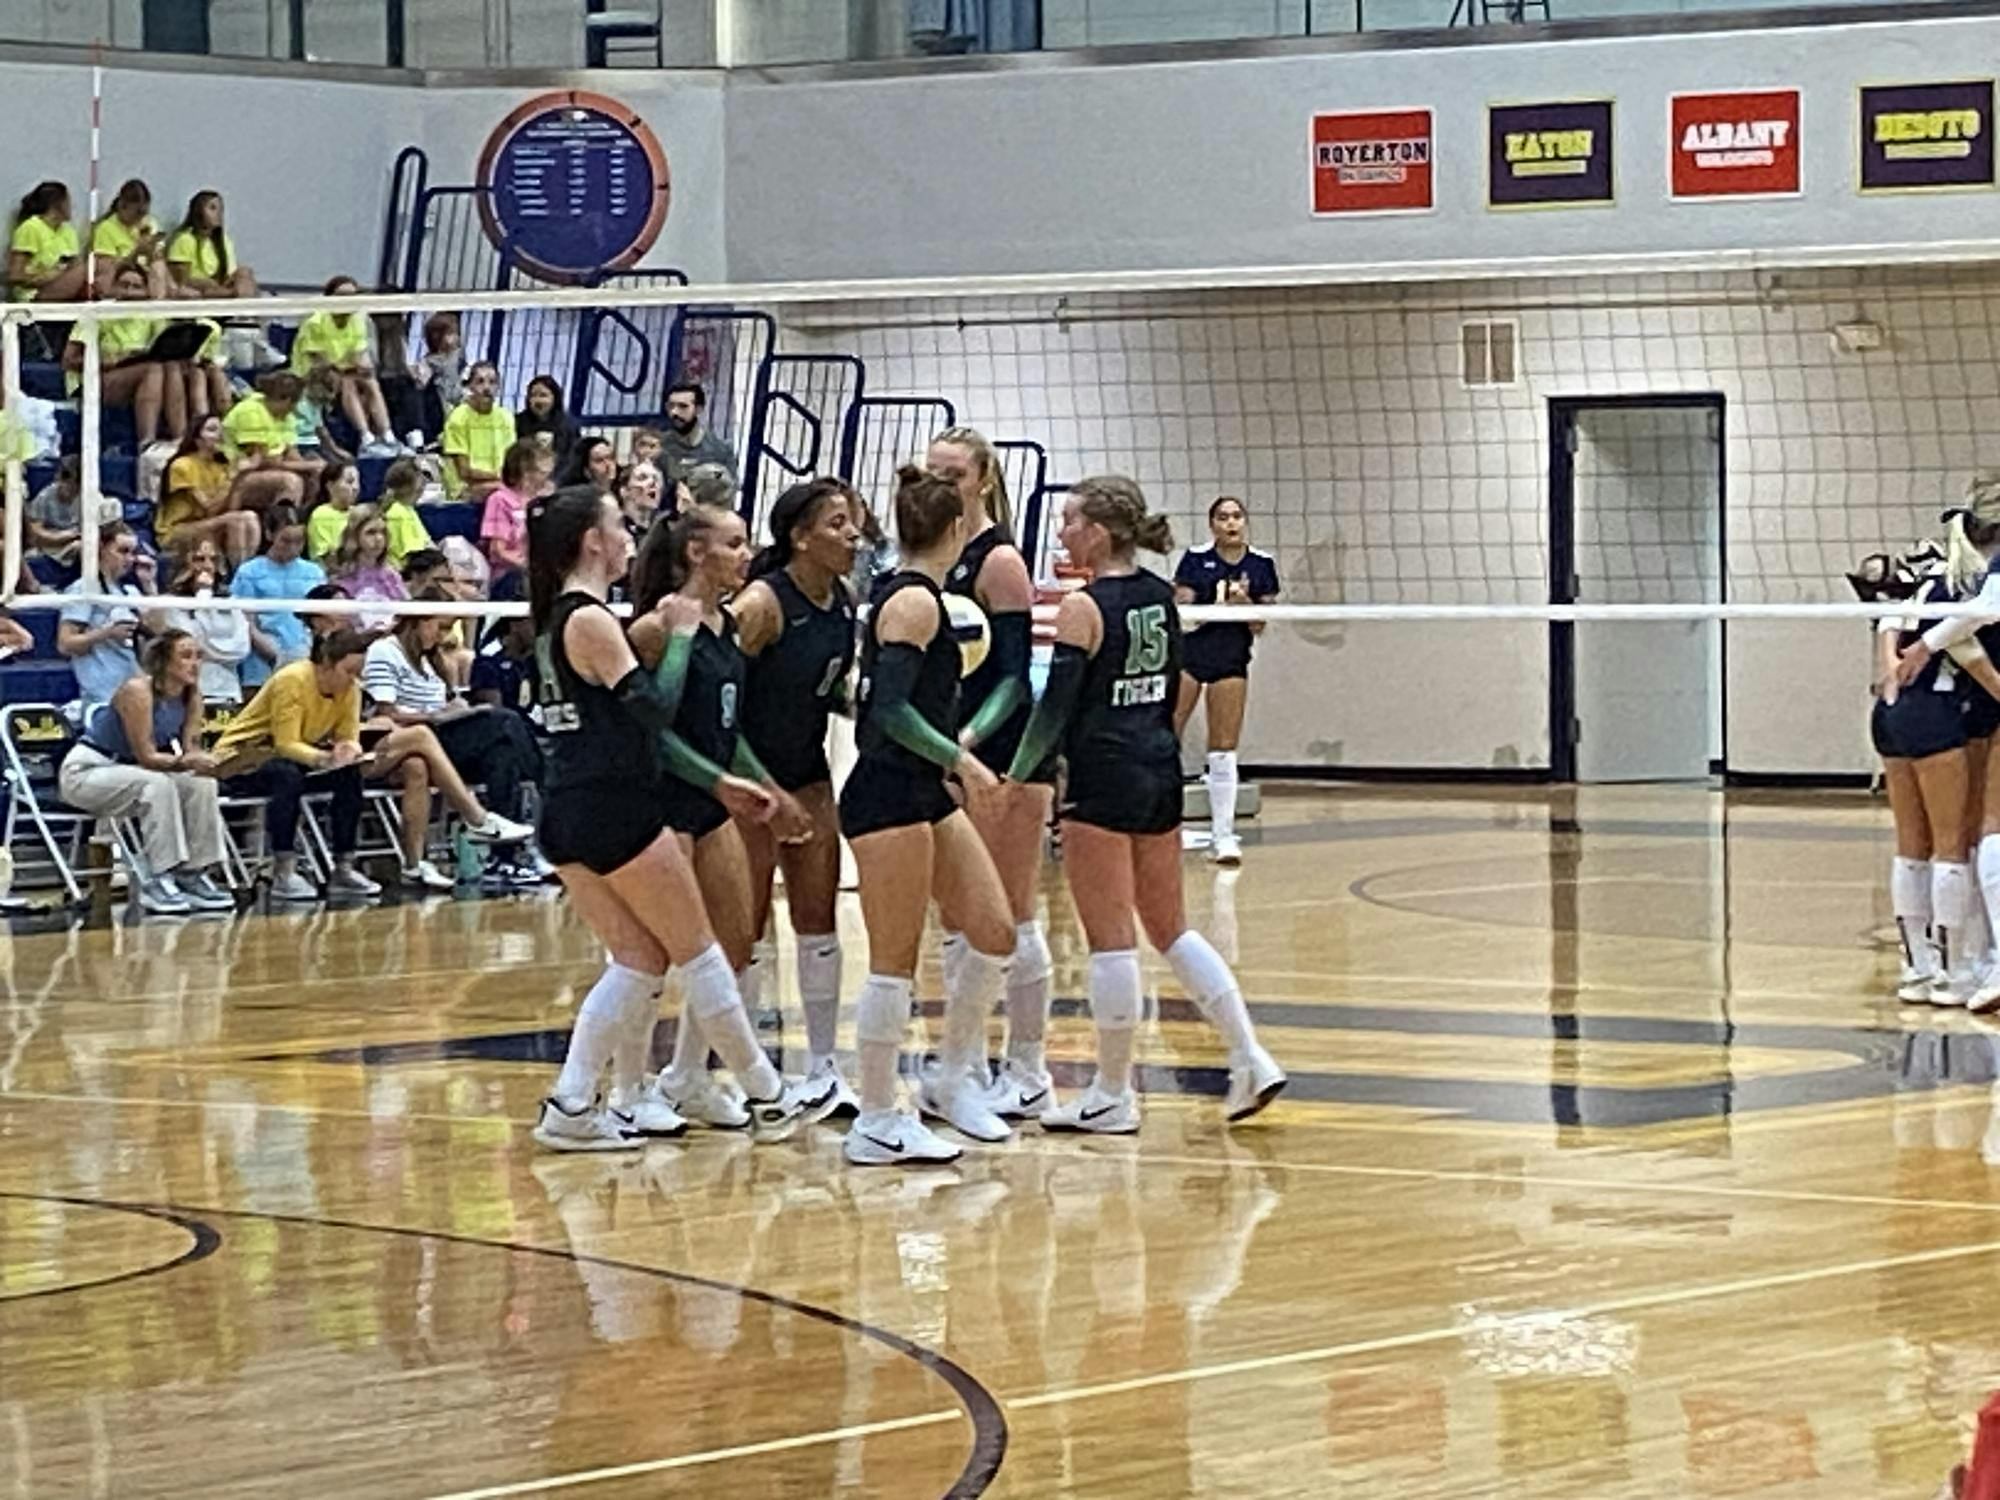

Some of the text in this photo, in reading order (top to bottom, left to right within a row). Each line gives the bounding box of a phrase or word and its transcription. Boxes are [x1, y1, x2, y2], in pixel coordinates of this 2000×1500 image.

[1504, 130, 1593, 162] EATON
[1681, 120, 1791, 152] ALBANY
[1319, 142, 1427, 163] ROYERTON
[1125, 604, 1169, 675] 15
